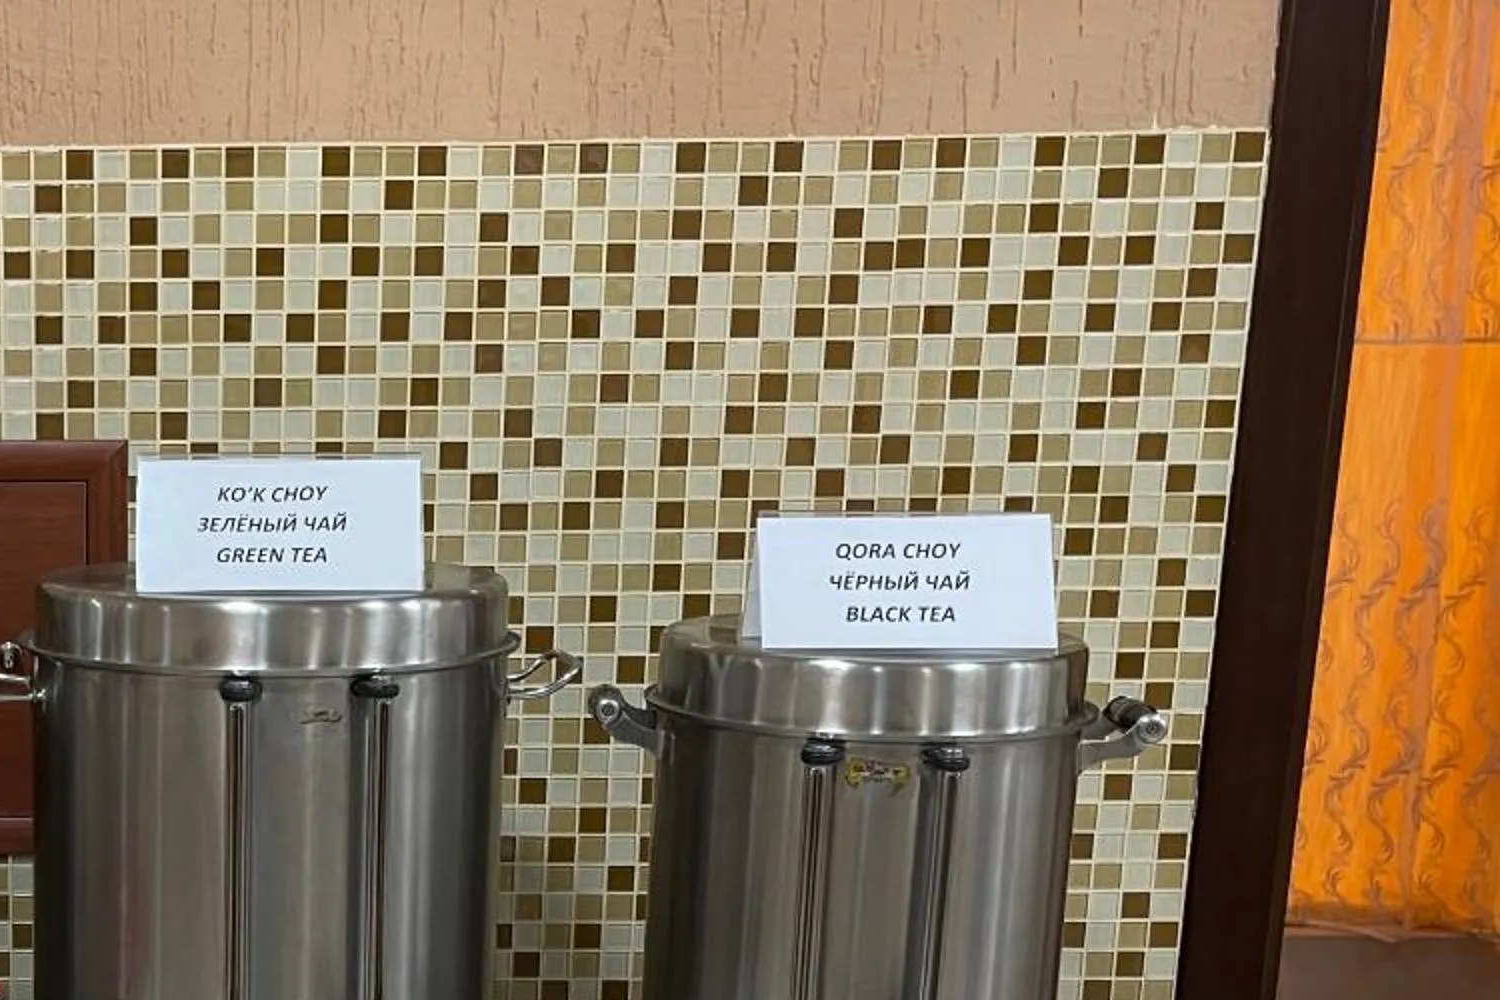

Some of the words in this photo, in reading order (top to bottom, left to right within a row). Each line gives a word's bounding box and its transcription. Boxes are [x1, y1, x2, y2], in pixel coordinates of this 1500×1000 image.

[271, 486, 329, 502] CHOY
[198, 513, 297, 533] ЗЕЛЁНЫЙ
[304, 512, 347, 531] ЧАЙ
[217, 548, 285, 564] GREEN
[291, 547, 328, 564] TEA
[835, 543, 897, 560] QORA
[903, 543, 961, 559] CHOY
[829, 570, 919, 591] ЧЁРНЫЙ
[925, 570, 971, 590] ЧАЙ
[846, 606, 912, 623] BLACK
[918, 606, 956, 623] TEA
